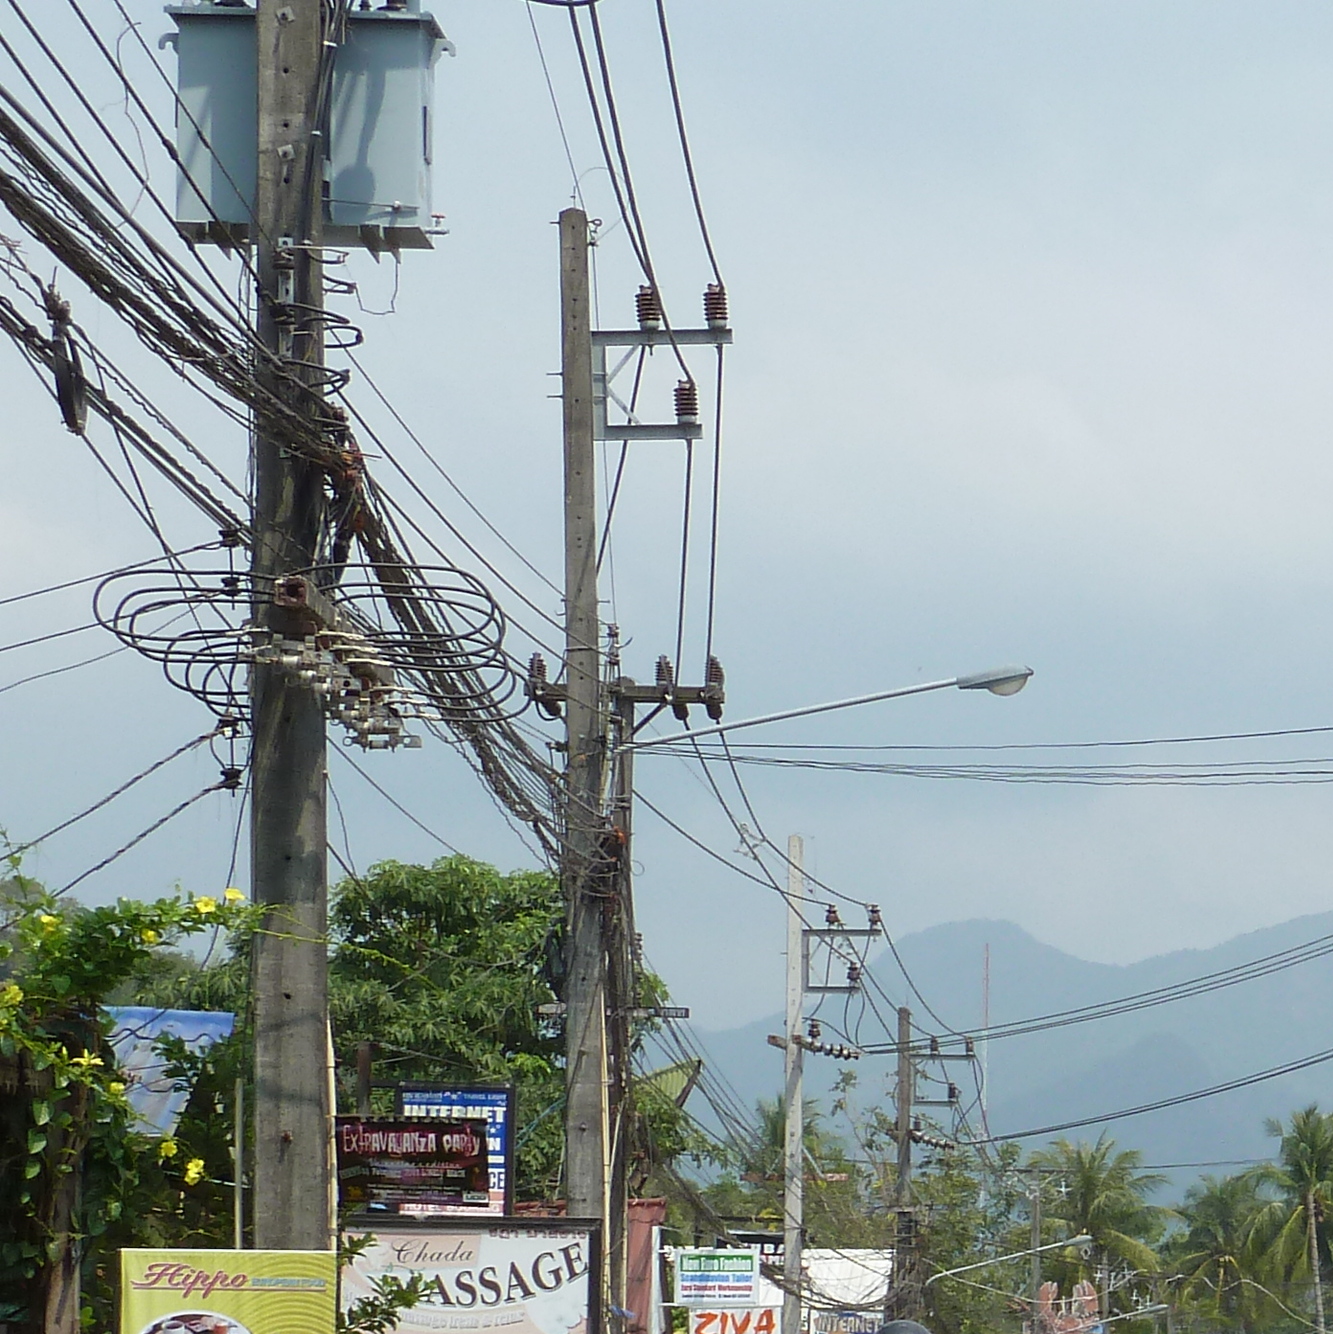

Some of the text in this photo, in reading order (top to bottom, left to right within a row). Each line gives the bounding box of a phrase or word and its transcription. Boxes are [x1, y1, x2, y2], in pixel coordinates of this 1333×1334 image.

[403, 1104, 507, 1123] INTERNET
[391, 1239, 474, 1264] Chada
[131, 1262, 250, 1300] Hippo
[424, 1241, 590, 1309] ASSAGE
[817, 1312, 881, 1334] INTERNET
